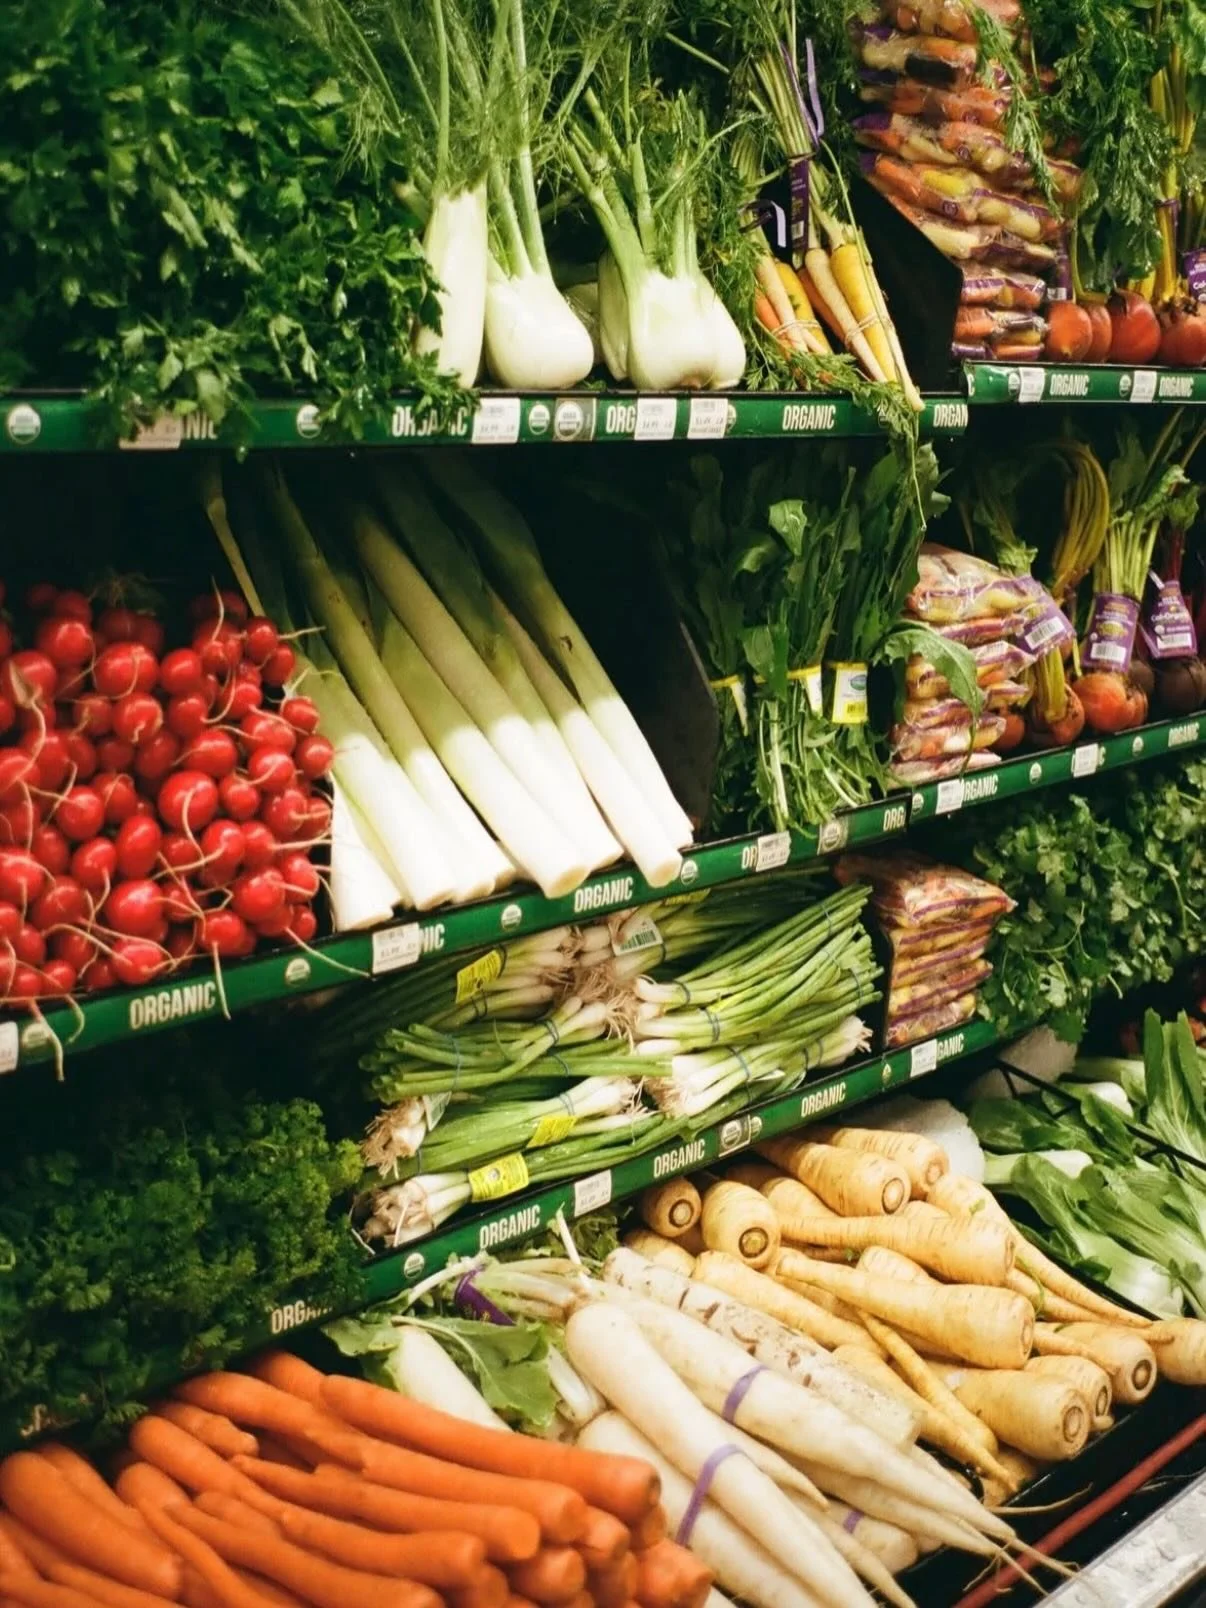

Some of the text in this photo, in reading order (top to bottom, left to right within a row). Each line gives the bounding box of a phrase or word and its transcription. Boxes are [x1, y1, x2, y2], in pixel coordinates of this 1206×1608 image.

[1050, 373, 1090, 396] ORGANIC
[1158, 376, 1195, 398] ORGANIC
[782, 403, 837, 431] ORGANIC
[1167, 720, 1200, 749] ORGANIC
[573, 875, 635, 914] ORGANIC
[129, 980, 217, 1031] ORGANIC
[801, 1081, 847, 1119] ORGANIC
[653, 1138, 706, 1179] ORGANIC
[479, 1204, 541, 1250] ORGANIC
